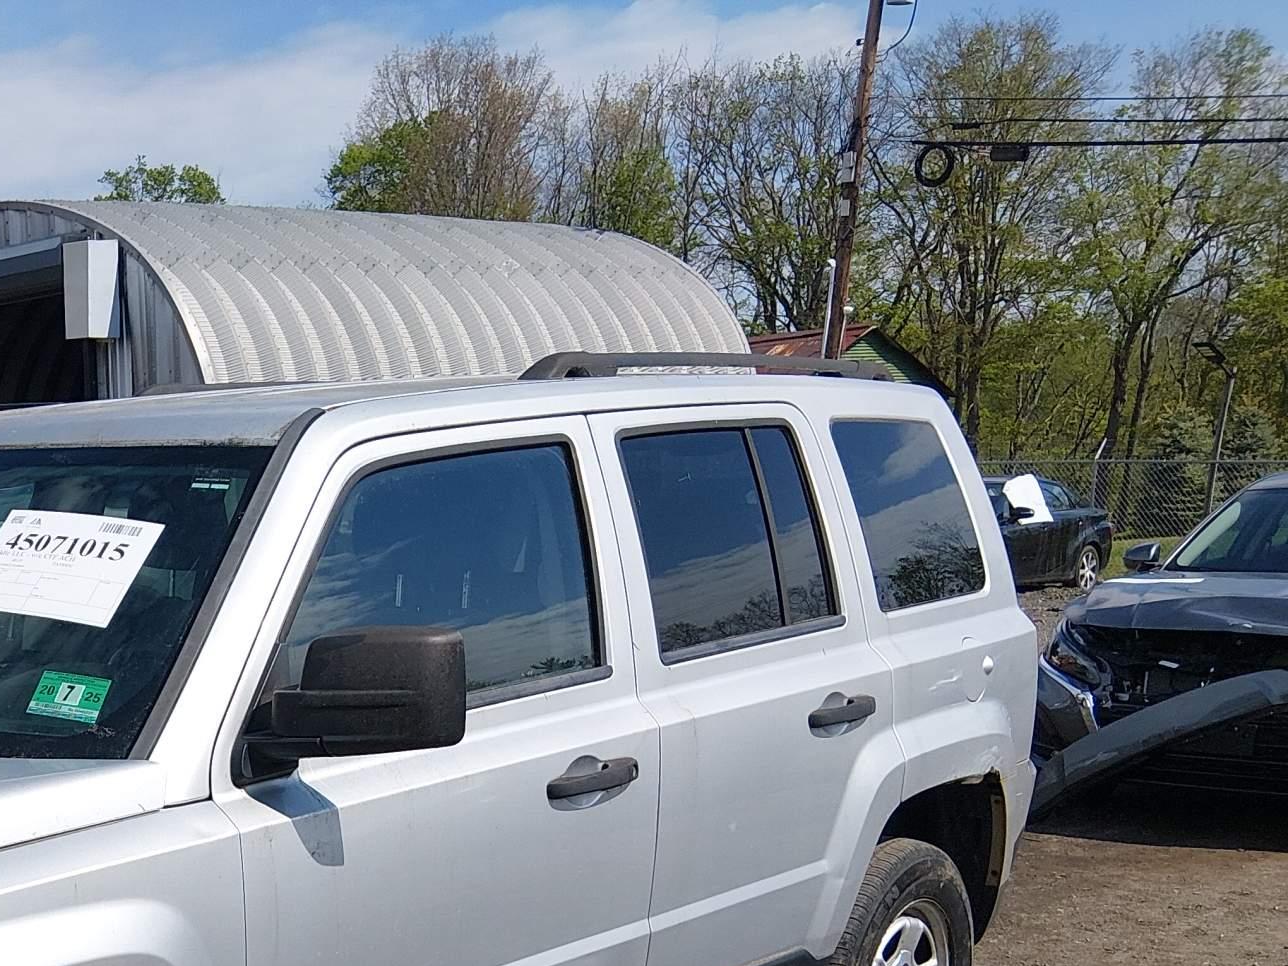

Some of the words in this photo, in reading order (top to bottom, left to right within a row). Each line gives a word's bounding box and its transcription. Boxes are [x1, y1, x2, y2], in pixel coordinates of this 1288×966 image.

[5, 532, 130, 562] 45071015
[39, 684, 56, 696] 20
[63, 685, 76, 702] 7
[84, 691, 103, 704] 25
